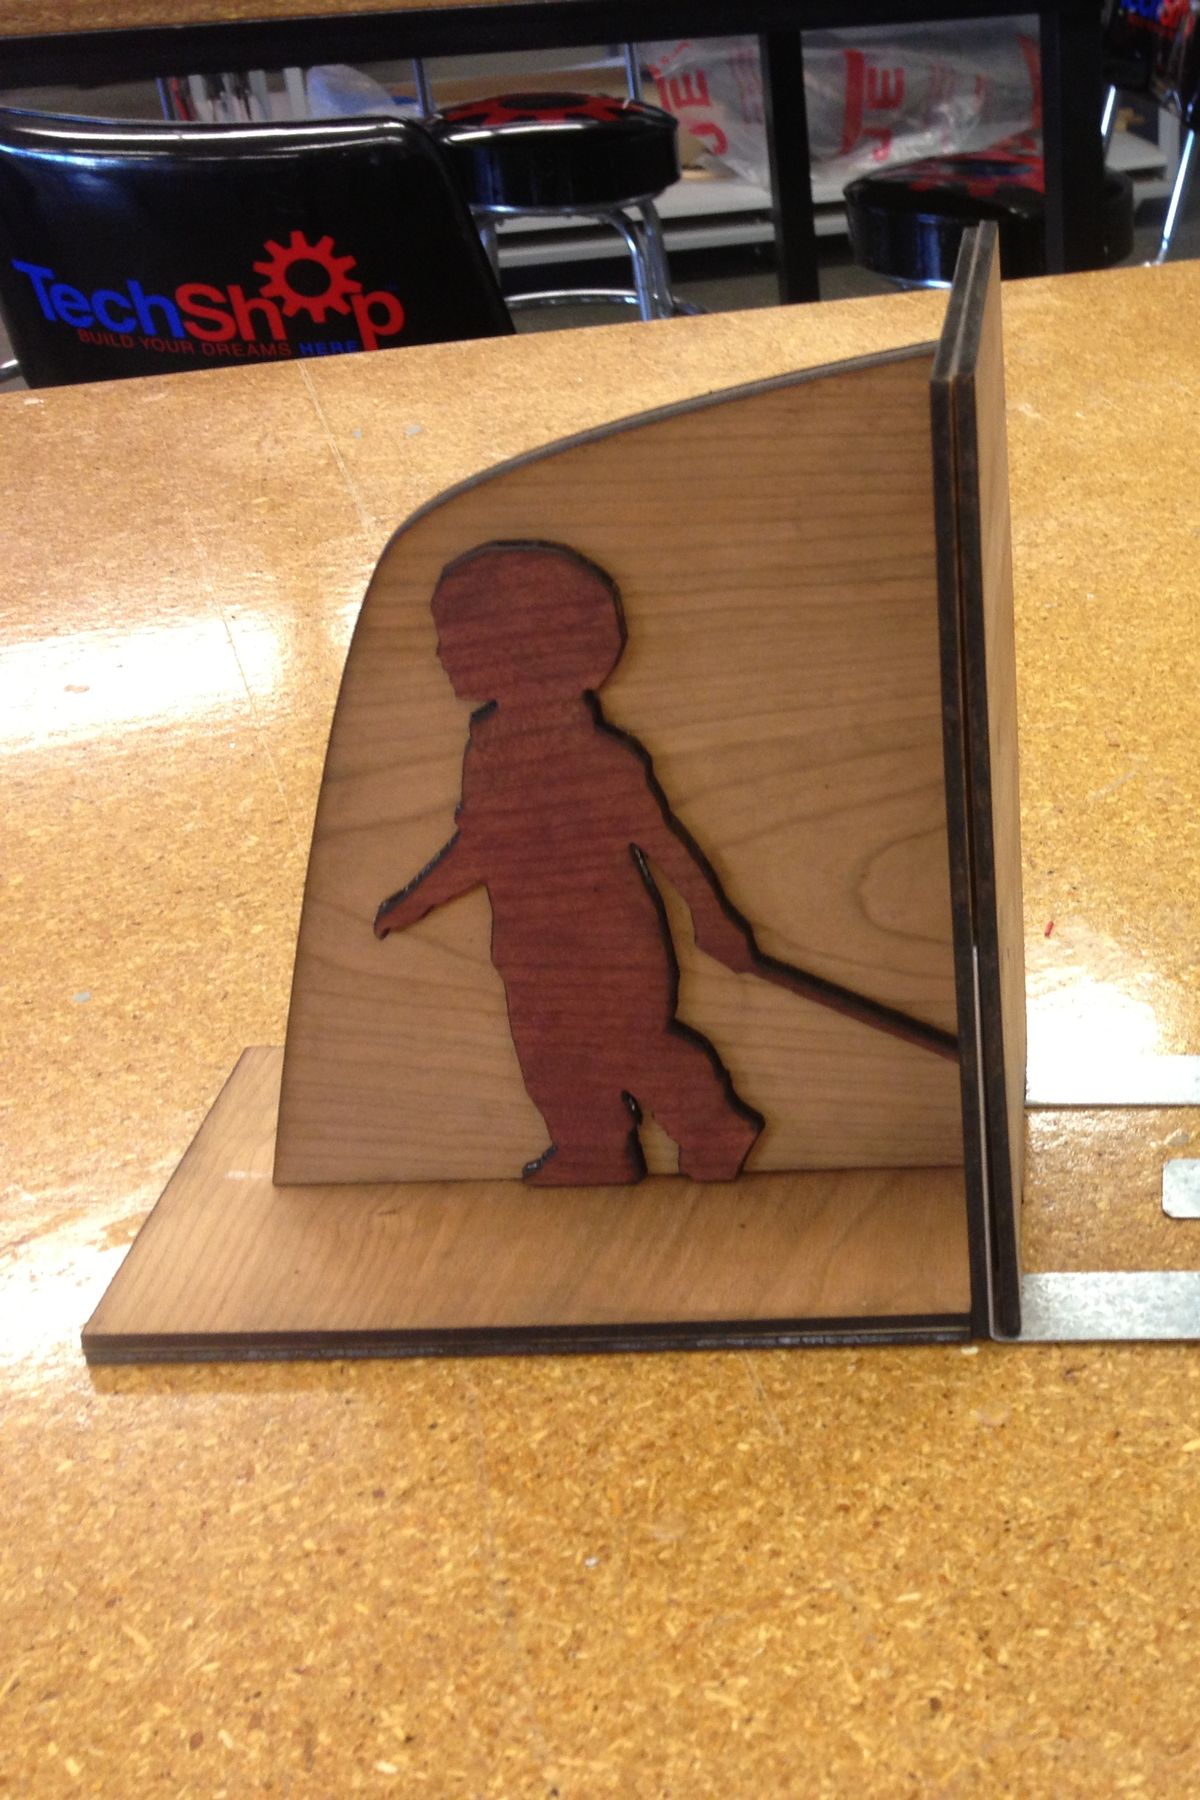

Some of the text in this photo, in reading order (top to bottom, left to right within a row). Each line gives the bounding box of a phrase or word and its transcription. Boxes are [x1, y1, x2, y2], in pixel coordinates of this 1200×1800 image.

[11, 230, 405, 351] TechShop
[77, 328, 358, 357] BUILD YOUR DREAMS HERE
